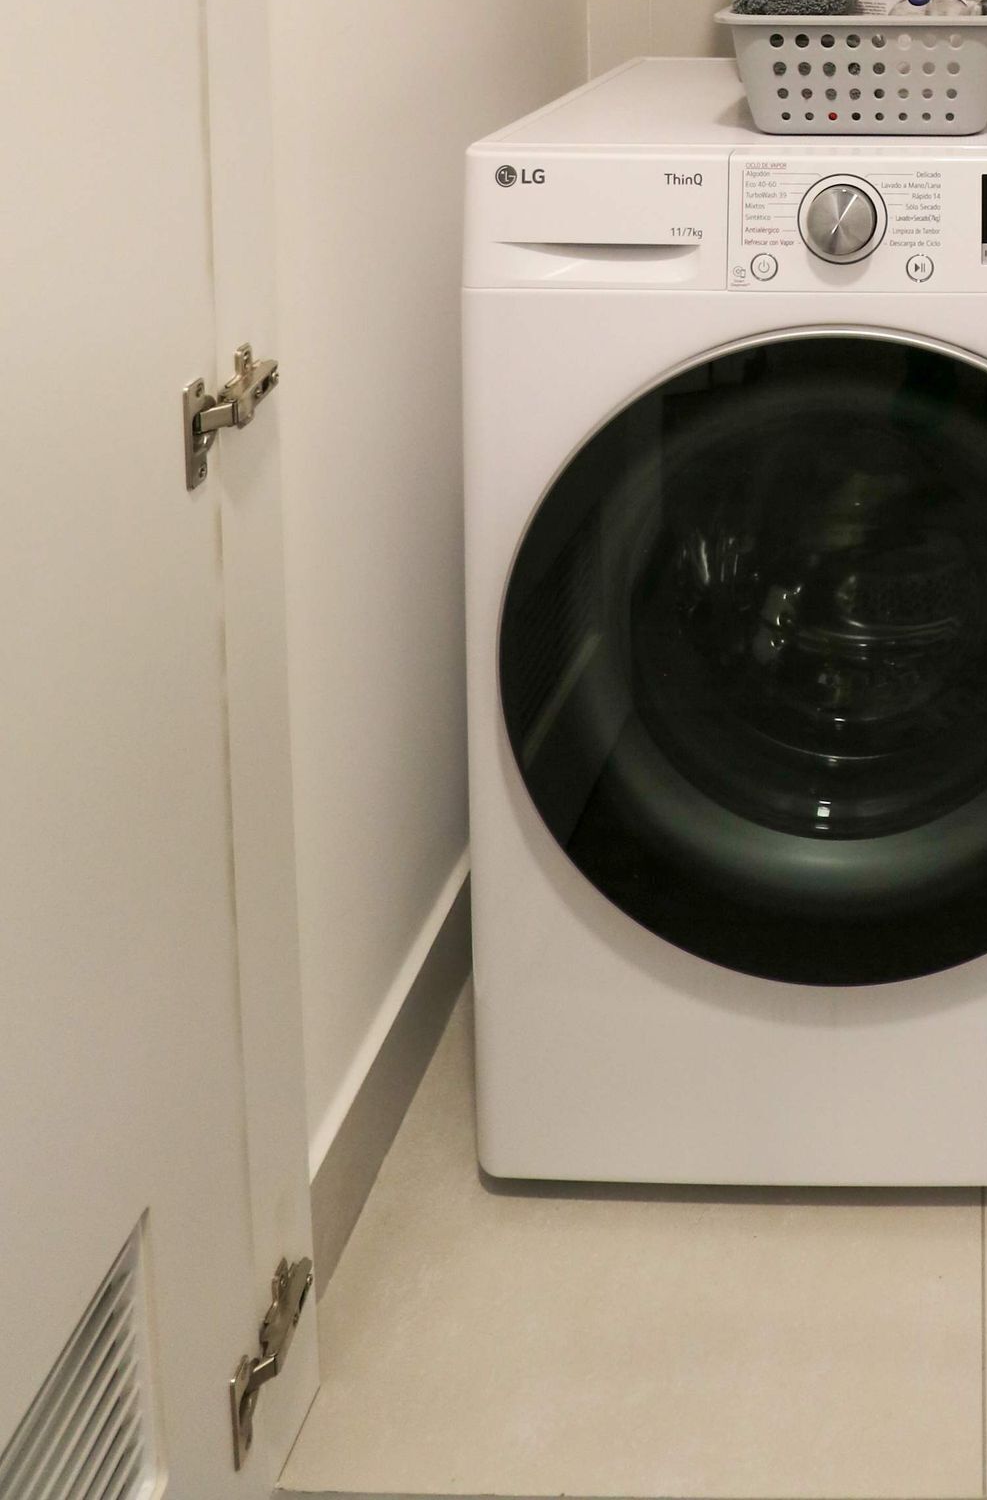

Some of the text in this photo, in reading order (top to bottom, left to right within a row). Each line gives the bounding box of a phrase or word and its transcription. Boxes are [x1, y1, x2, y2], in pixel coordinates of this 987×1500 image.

[521, 168, 546, 184] LG
[745, 170, 771, 178] Algodón
[664, 173, 703, 187] ThinQ
[912, 192, 933, 201] Rápido
[670, 227, 703, 239] 11/7kg
[889, 240, 916, 248] Descarga
